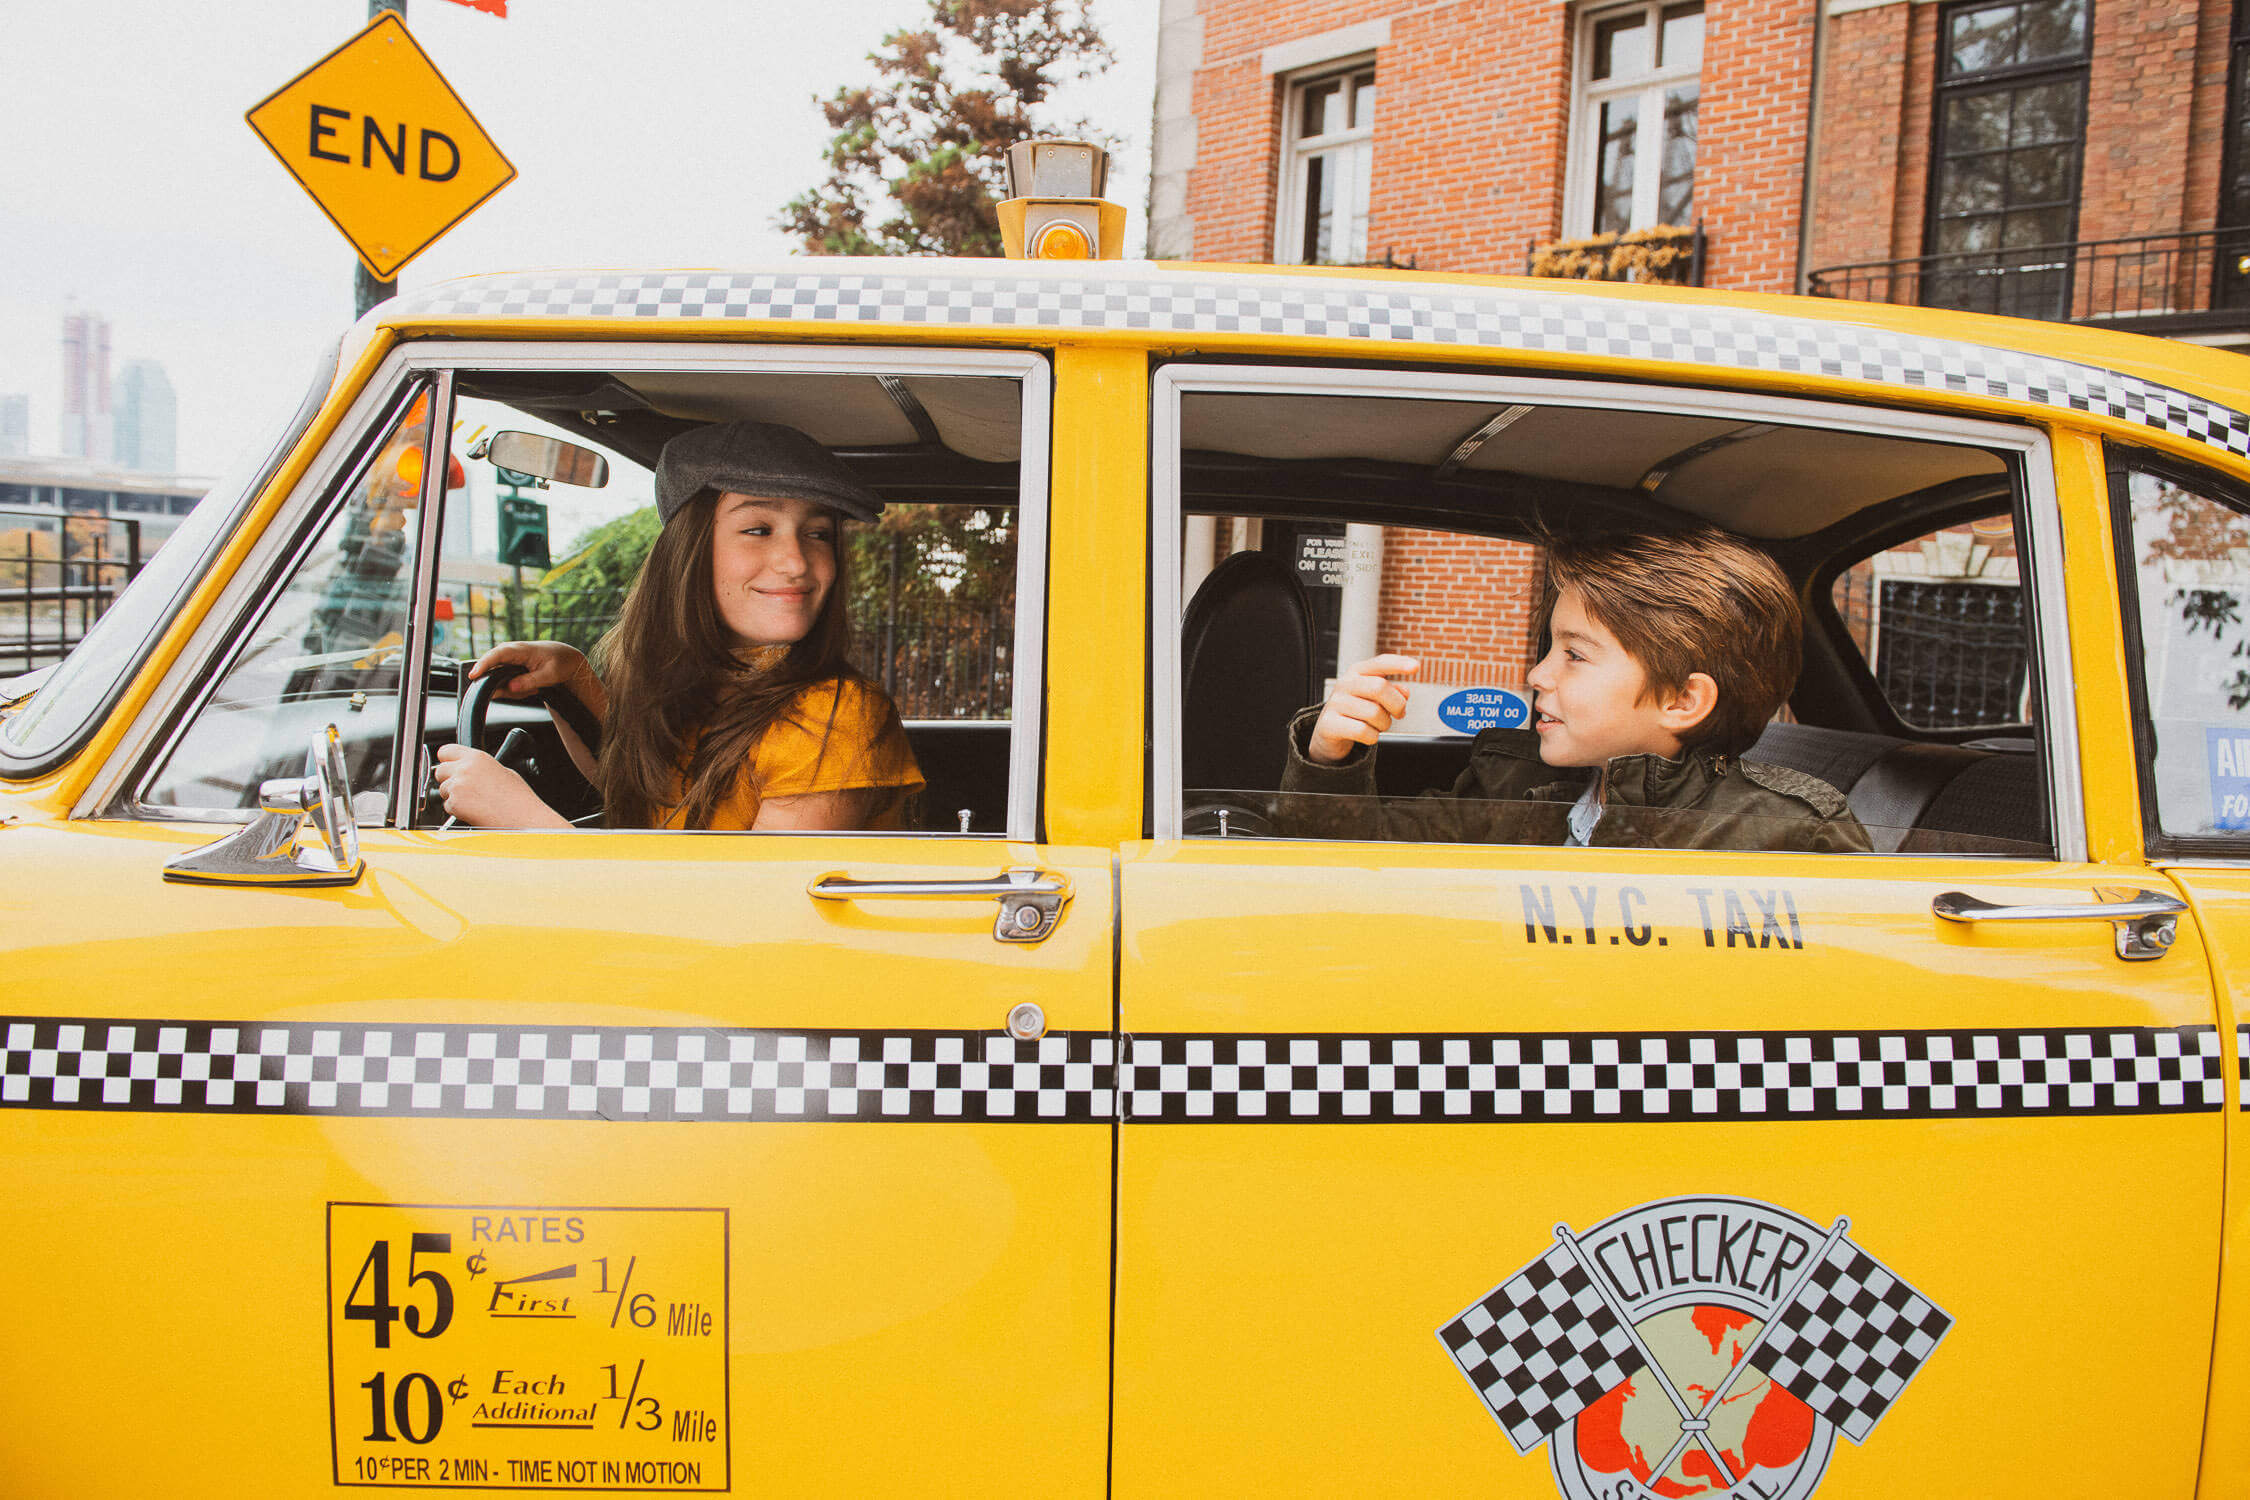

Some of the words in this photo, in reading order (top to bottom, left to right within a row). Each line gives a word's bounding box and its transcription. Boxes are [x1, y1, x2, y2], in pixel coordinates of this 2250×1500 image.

[309, 103, 461, 182] END
[1298, 560, 1316, 571] ON
[2222, 793, 2250, 818] FO
[1519, 884, 1668, 947] N.Y.C.
[1686, 887, 1803, 950] TAXI
[471, 1215, 585, 1244] RATES
[1594, 1214, 1810, 1303] CHECKER
[486, 1263, 577, 1313] First
[592, 1255, 657, 1329] 1/6
[667, 1303, 713, 1337] Mile
[471, 1402, 598, 1422] Additional
[491, 1369, 566, 1396] Each
[600, 1358, 663, 1431] 1/3
[672, 1409, 717, 1443] Mile
[439, 1458, 450, 1480] 2
[507, 1459, 552, 1483] TIME
[558, 1460, 597, 1483] NOT
[603, 1461, 620, 1484] IN
[625, 1461, 701, 1485] MOTION
